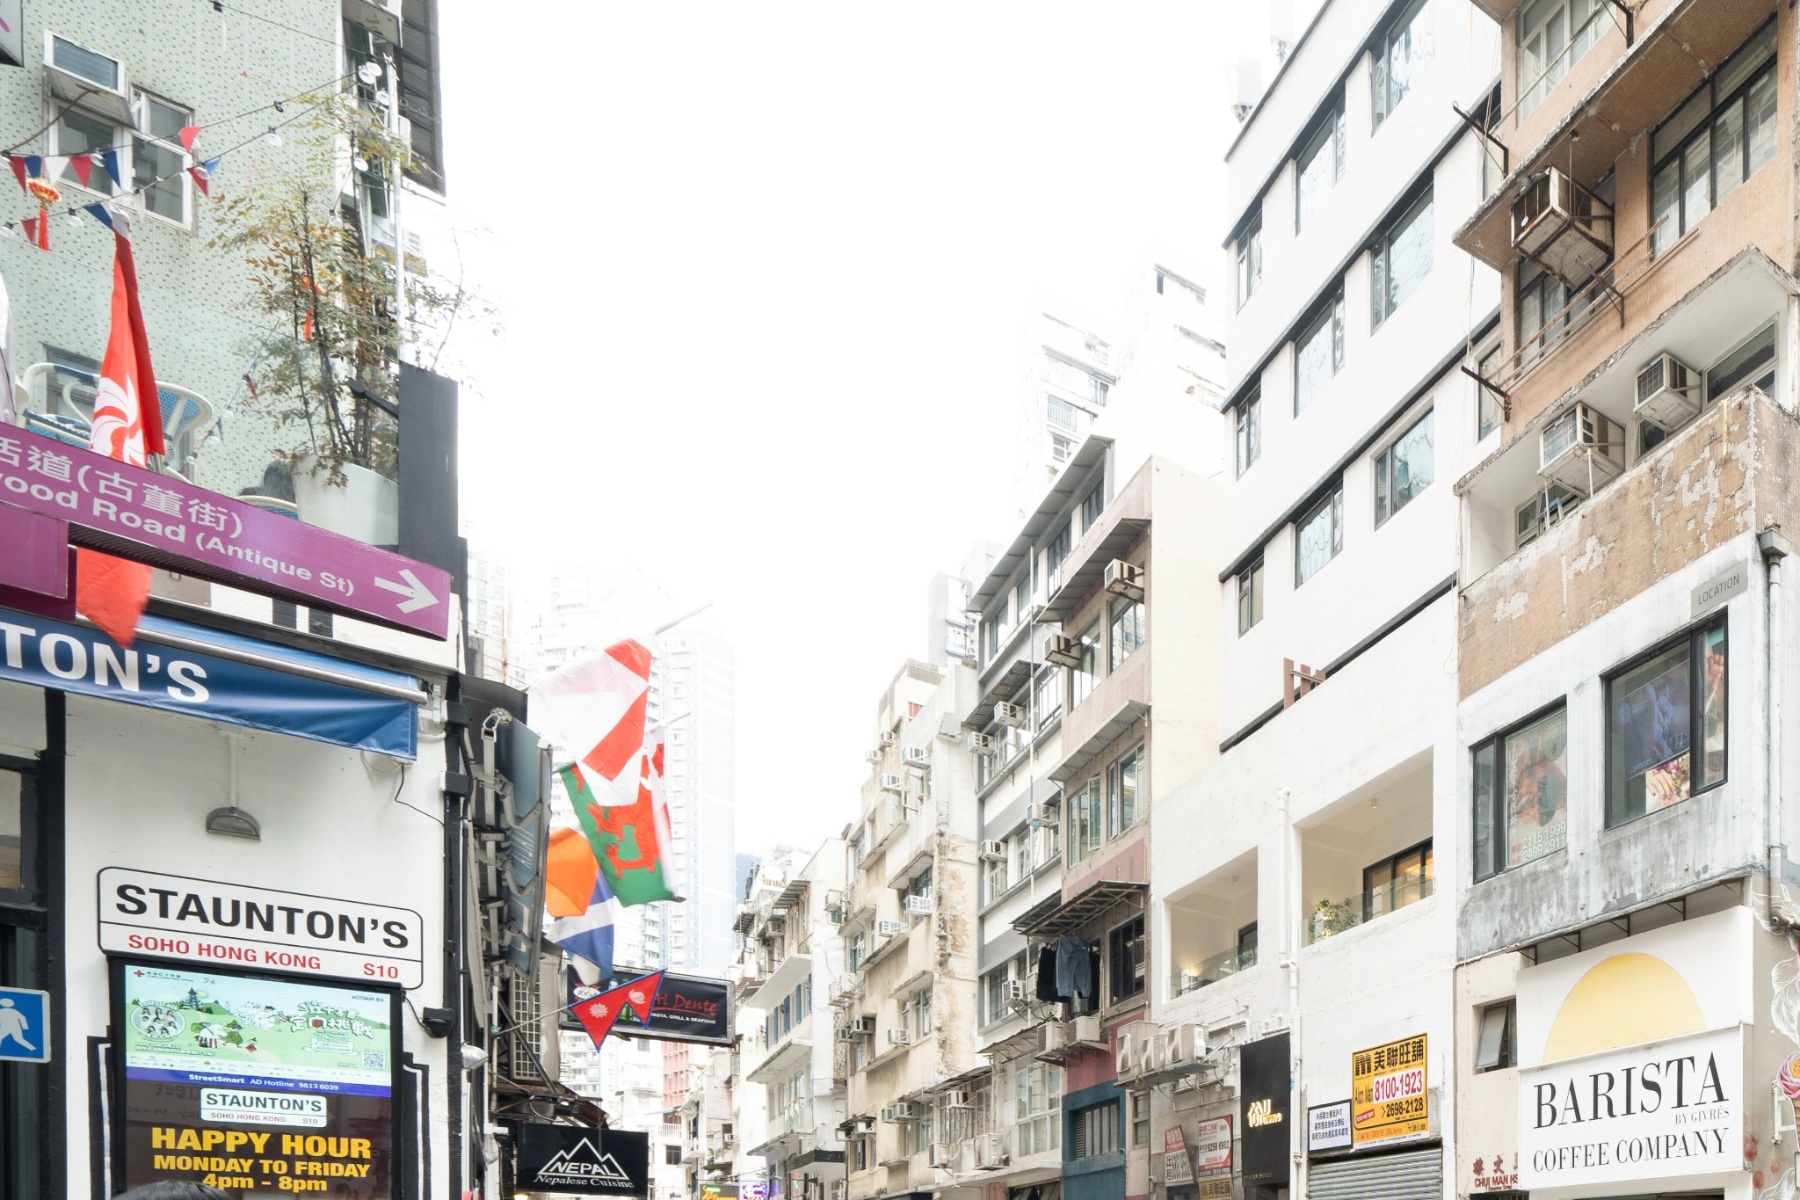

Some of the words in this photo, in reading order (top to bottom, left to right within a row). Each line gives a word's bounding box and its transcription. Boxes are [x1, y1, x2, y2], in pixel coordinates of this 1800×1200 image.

[0, 472, 78, 510] ood
[93, 497, 186, 543] Road
[196, 532, 312, 579] (Antique
[319, 571, 355, 597] St)
[1698, 574, 1740, 605] LOCATION
[115, 883, 410, 949] STAUNTON'S
[128, 934, 190, 954] SOHO
[197, 943, 257, 963] HONG
[264, 950, 321, 970] KONG
[363, 963, 399, 979] S10
[673, 993, 717, 1012] Dente
[1374, 1039, 1424, 1071] 美聯旺舖
[189, 1074, 245, 1084] StreetSmart
[250, 1078, 262, 1086] AD
[264, 1080, 294, 1088] Hotline
[298, 1082, 317, 1090] 9813
[1375, 1070, 1423, 1102] 8100-1923
[1533, 1051, 1729, 1129] BARISTA
[206, 1093, 322, 1112] STAUNTON'S
[1386, 1097, 1424, 1117] 2698-2128
[210, 1112, 235, 1120] SOHO
[262, 1115, 286, 1123] KONG
[302, 1117, 318, 1125] S10
[1675, 1112, 1688, 1125] BY
[1691, 1106, 1730, 1122] GIVRÉS
[151, 1127, 270, 1154] HAPPY
[282, 1134, 371, 1159] HOUR
[1533, 1142, 1610, 1172] COFFEE
[1616, 1127, 1730, 1164] COMPANY
[153, 1154, 253, 1173] MONDAY
[259, 1159, 288, 1175] TO
[294, 1161, 370, 1178] FRIDAY
[549, 1161, 619, 1176] NEPAL
[202, 1173, 254, 1191] 4pm
[278, 1176, 327, 1193] 8pm
[534, 1175, 587, 1186] Nepalese
[590, 1179, 634, 1188] Cuisine
[1475, 1177, 1490, 1188] CHUI
[1492, 1174, 1509, 1186] MAN
